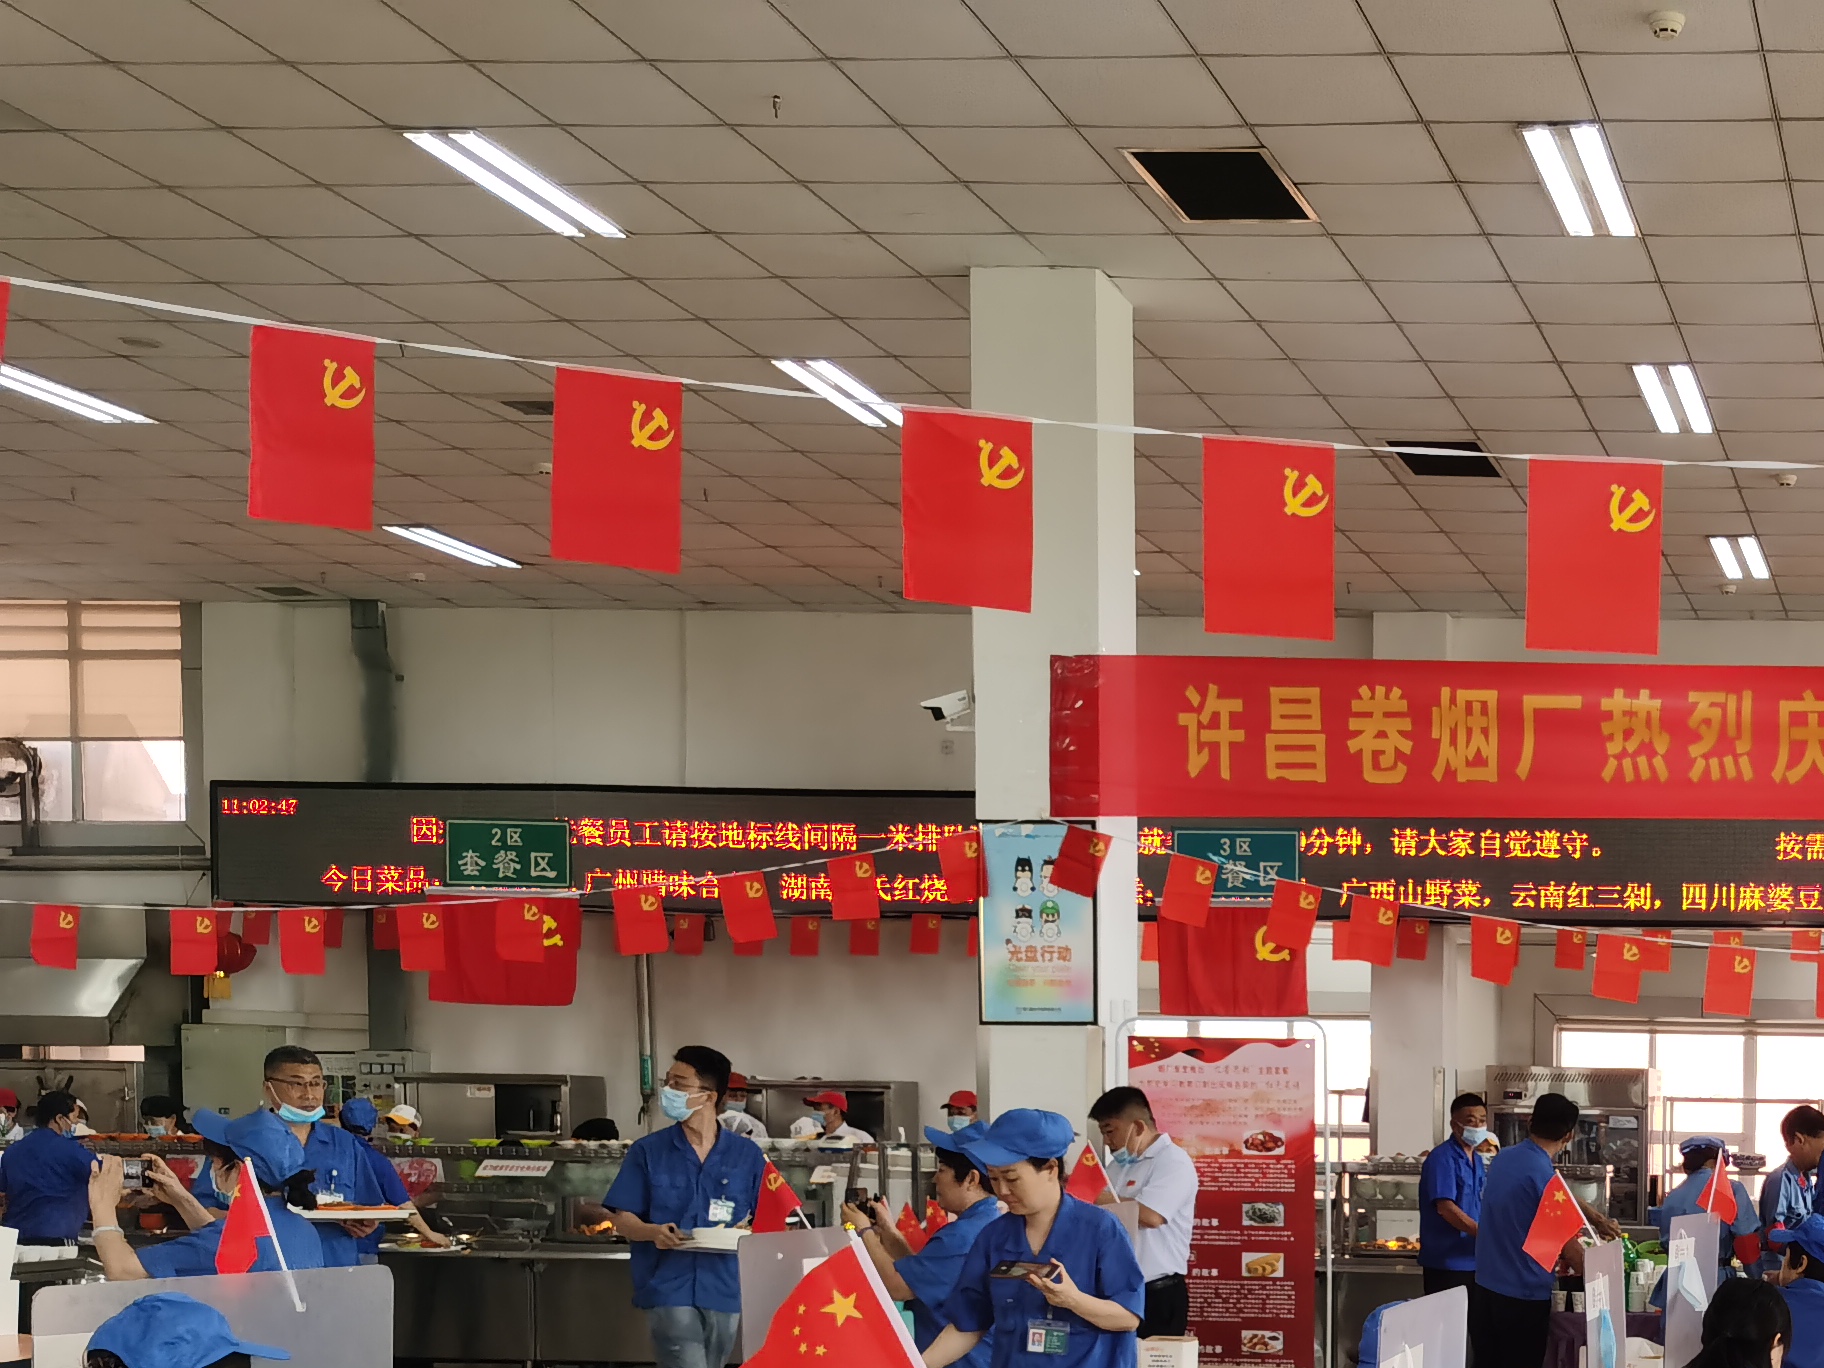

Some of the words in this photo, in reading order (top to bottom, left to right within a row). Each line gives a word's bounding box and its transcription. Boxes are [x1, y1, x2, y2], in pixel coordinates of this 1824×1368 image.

[221, 798, 299, 815] 11:02:47
[491, 827, 524, 847] 2区
[1219, 837, 1252, 857] 3区
[1300, 826, 1602, 860] 分钟，请大家自觉遵守。
[458, 849, 558, 878] 套餐区
[1221, 860, 1285, 889] 餐区
